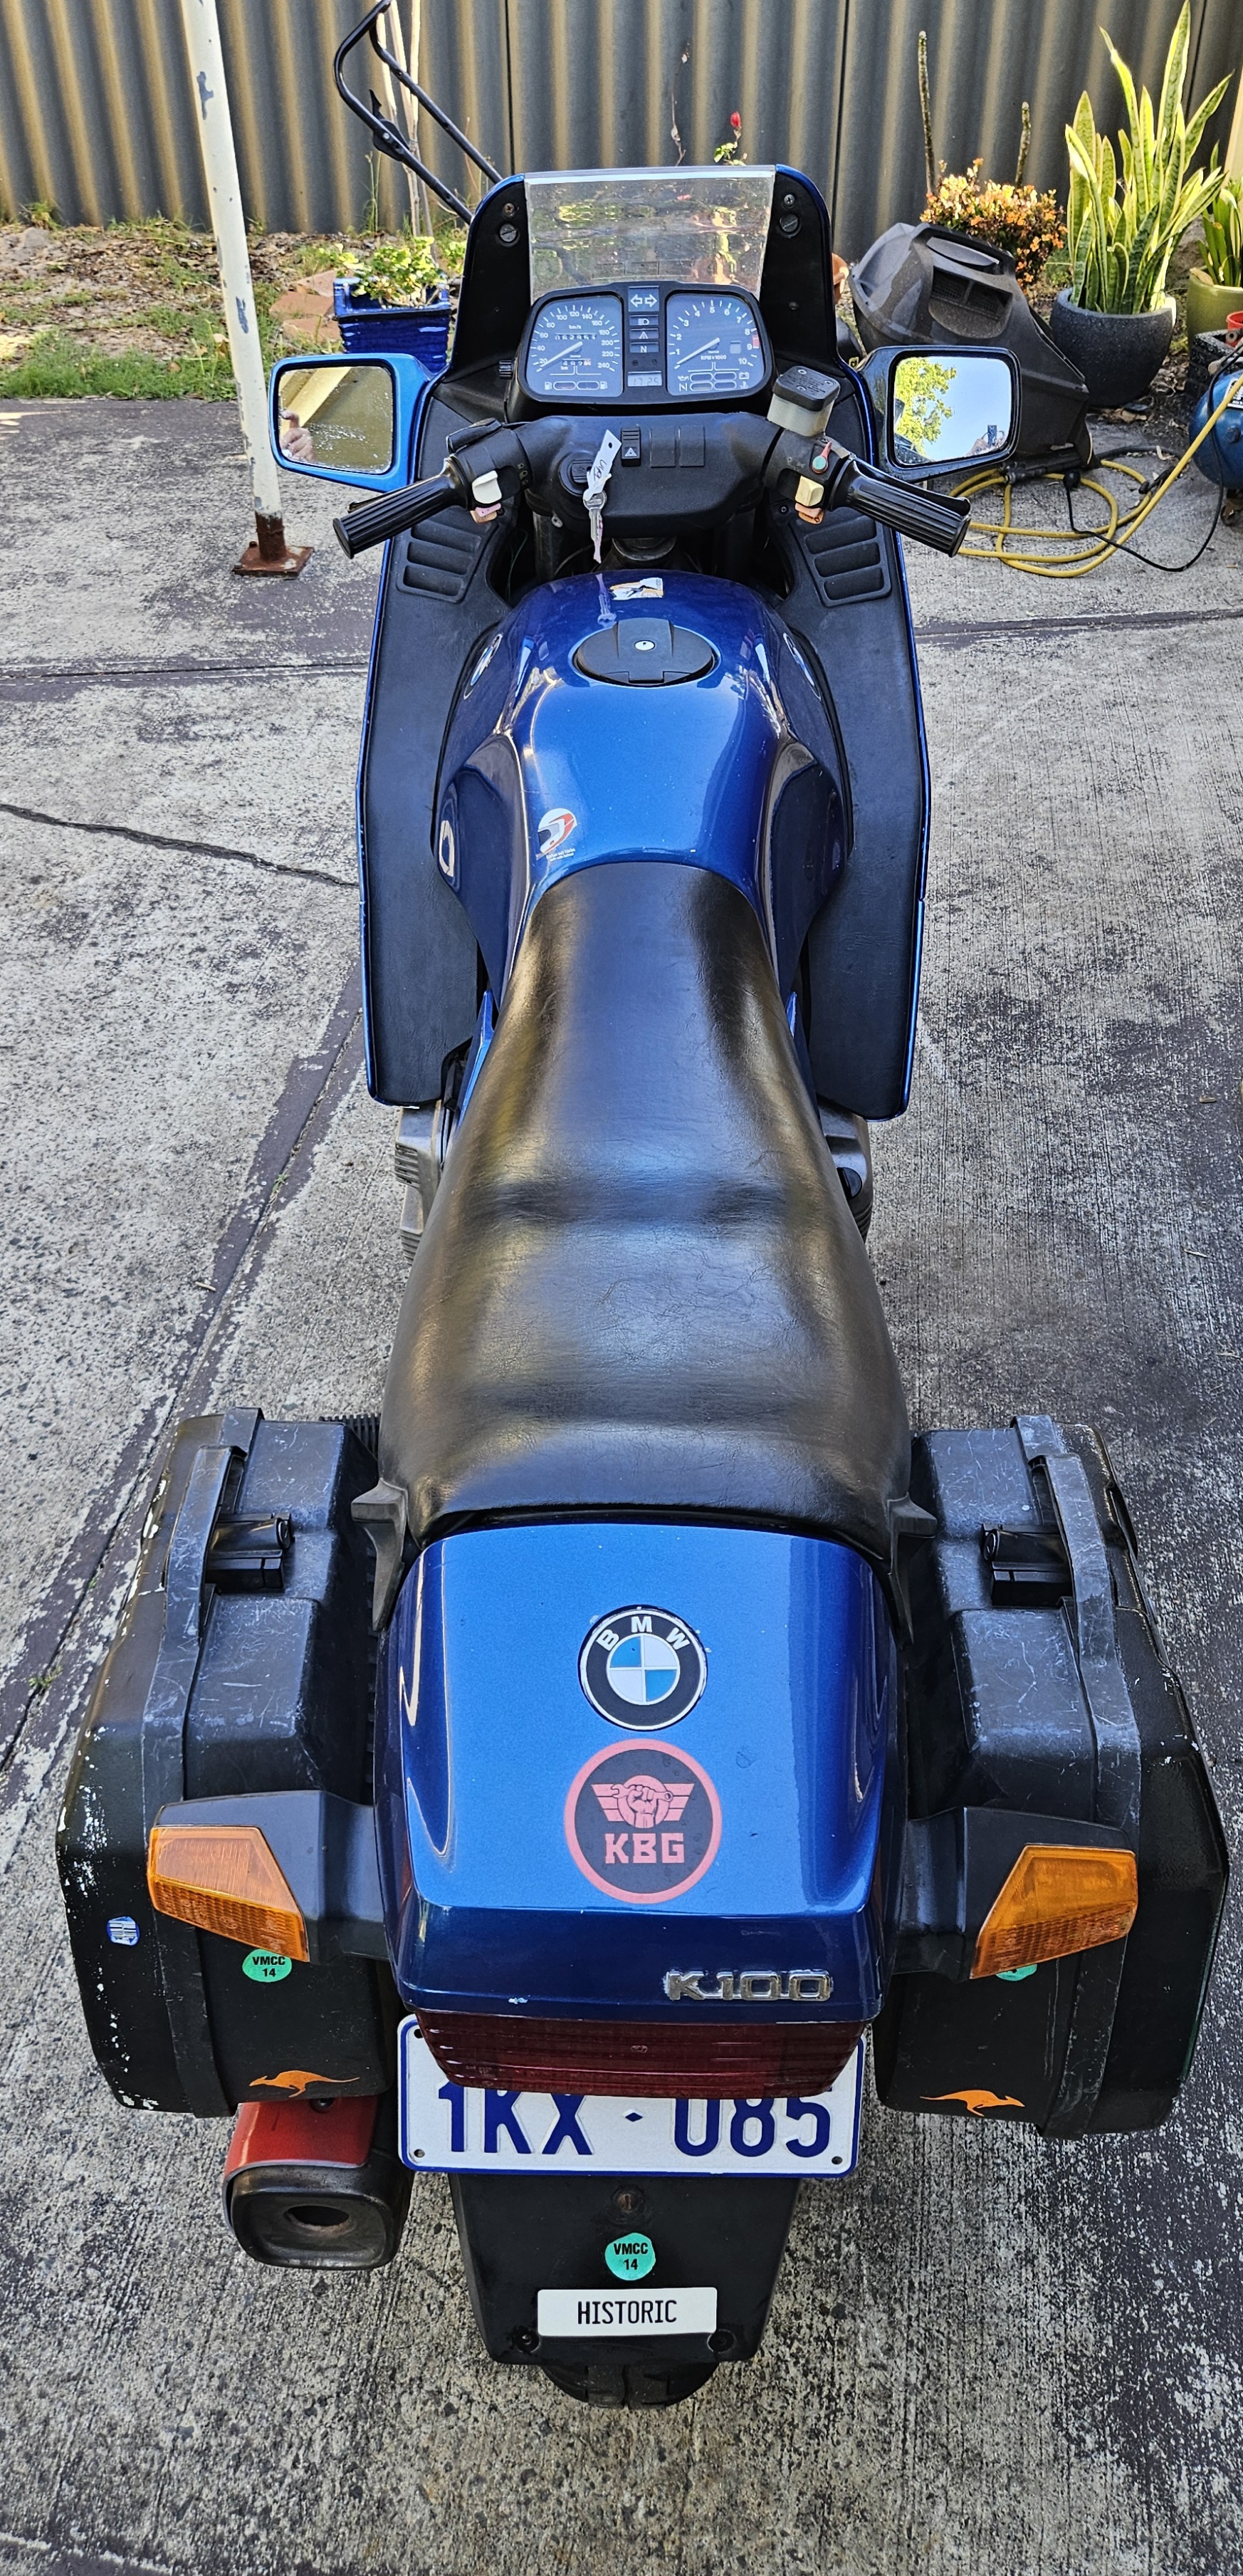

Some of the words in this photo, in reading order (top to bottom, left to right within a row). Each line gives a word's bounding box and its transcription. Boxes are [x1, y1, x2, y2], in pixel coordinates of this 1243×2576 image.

[678, 382, 688, 392] N
[596, 1616, 691, 1652] BMW
[605, 1832, 685, 1864] KBG
[252, 1956, 285, 1966] VMCC
[262, 1968, 276, 1977] 14
[667, 1970, 832, 2002] K100
[439, 2081, 593, 2155] 1KX
[674, 2087, 832, 2158] 085
[613, 2242, 649, 2256] VMCC
[623, 2258, 639, 2270] 14
[577, 2300, 677, 2325] HISTORIC
